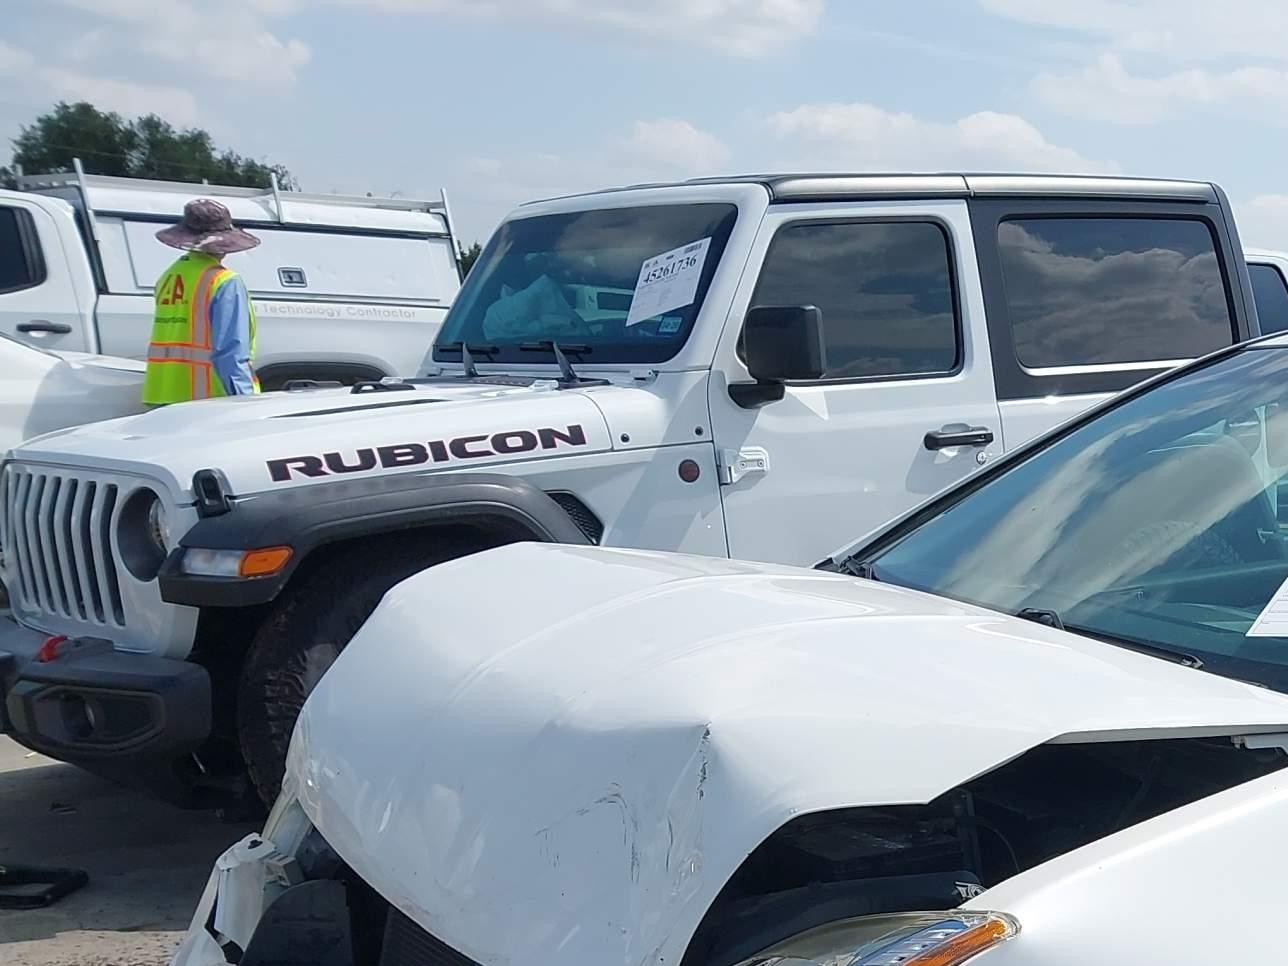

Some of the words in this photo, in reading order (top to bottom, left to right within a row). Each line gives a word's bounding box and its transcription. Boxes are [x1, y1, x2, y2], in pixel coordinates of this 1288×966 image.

[643, 254, 697, 283] 45261736
[262, 304, 341, 317] Technology
[347, 306, 416, 319] Contractor
[265, 424, 587, 482] RUBICON
